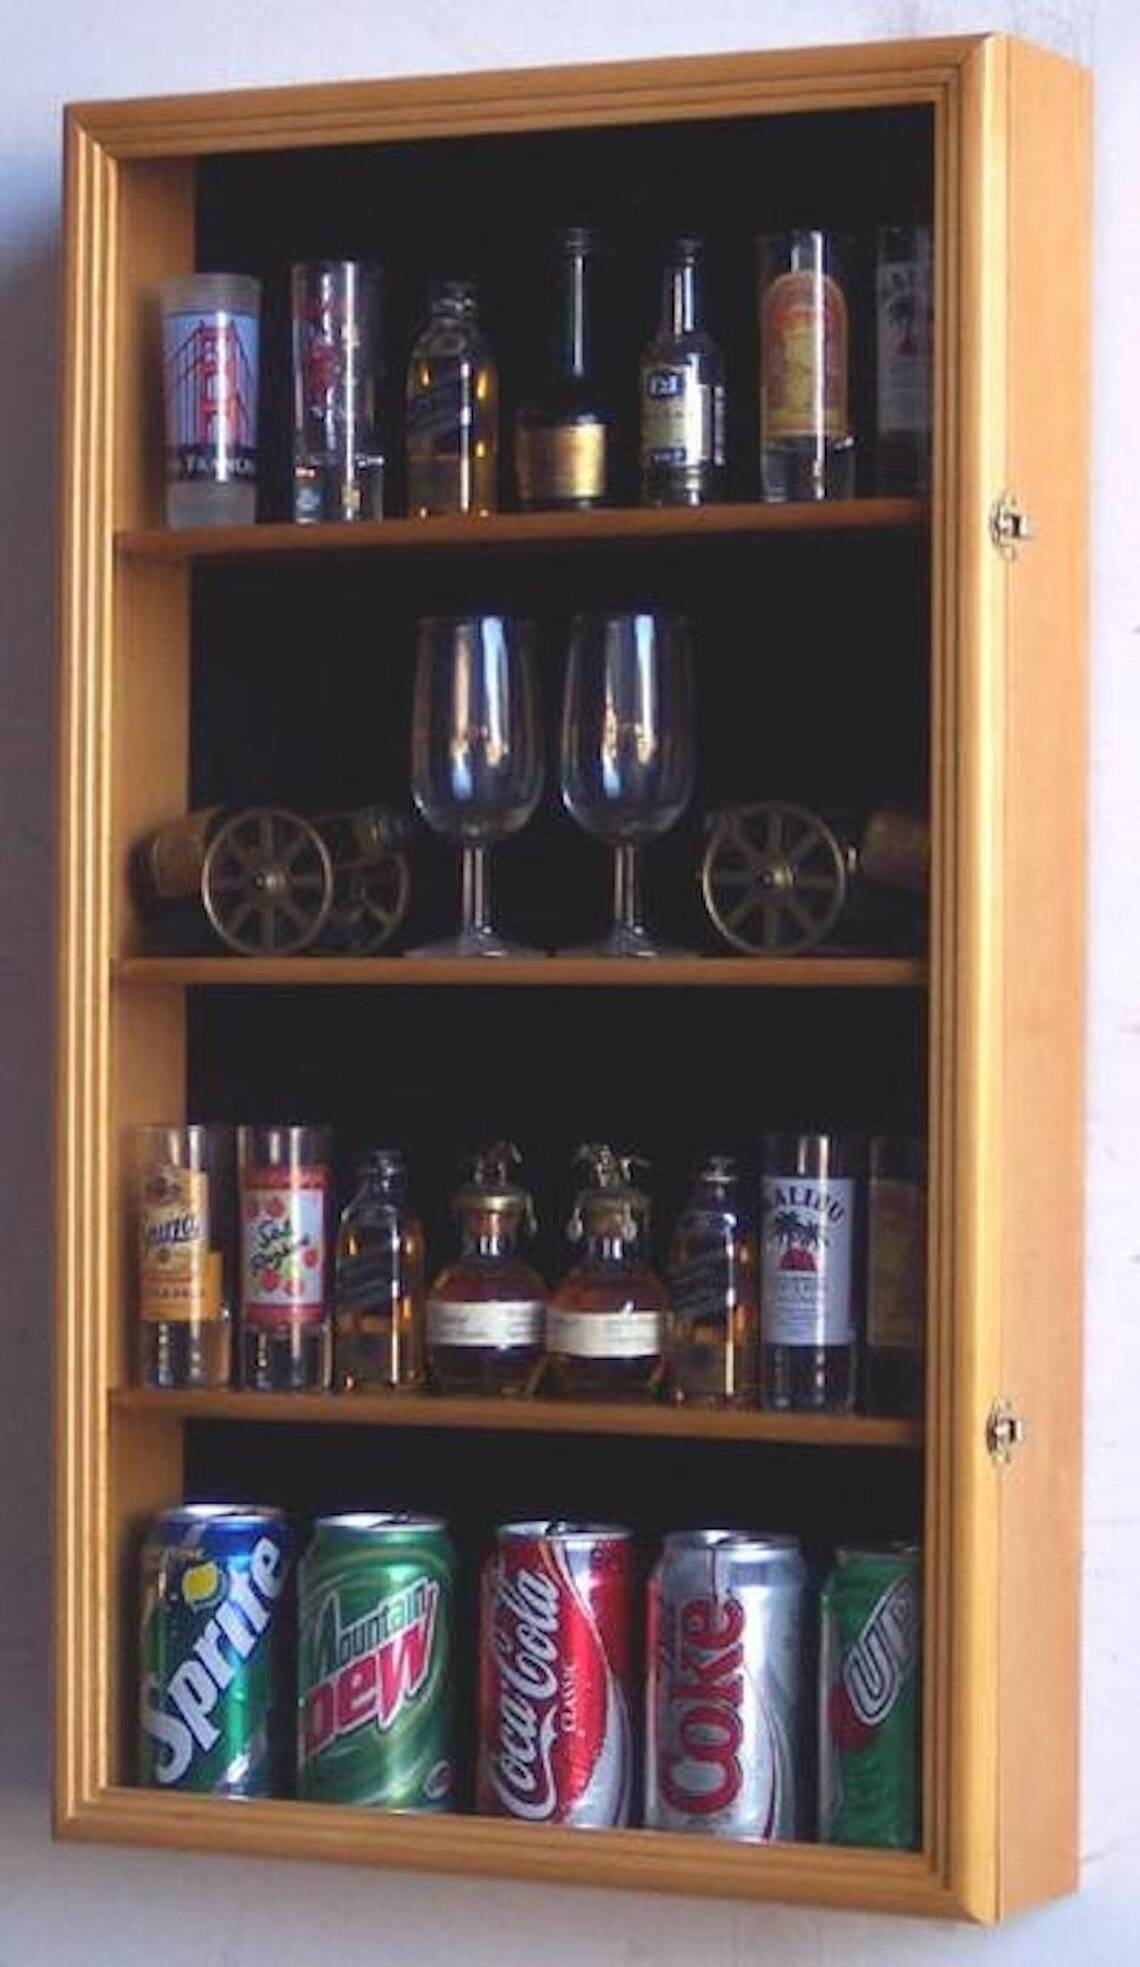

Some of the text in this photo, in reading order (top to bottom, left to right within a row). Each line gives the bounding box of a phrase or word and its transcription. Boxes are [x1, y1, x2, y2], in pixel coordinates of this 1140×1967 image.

[768, 1186, 846, 1223] ALIU
[140, 1536, 281, 1785] Sprite
[315, 1577, 430, 1680] Mountain
